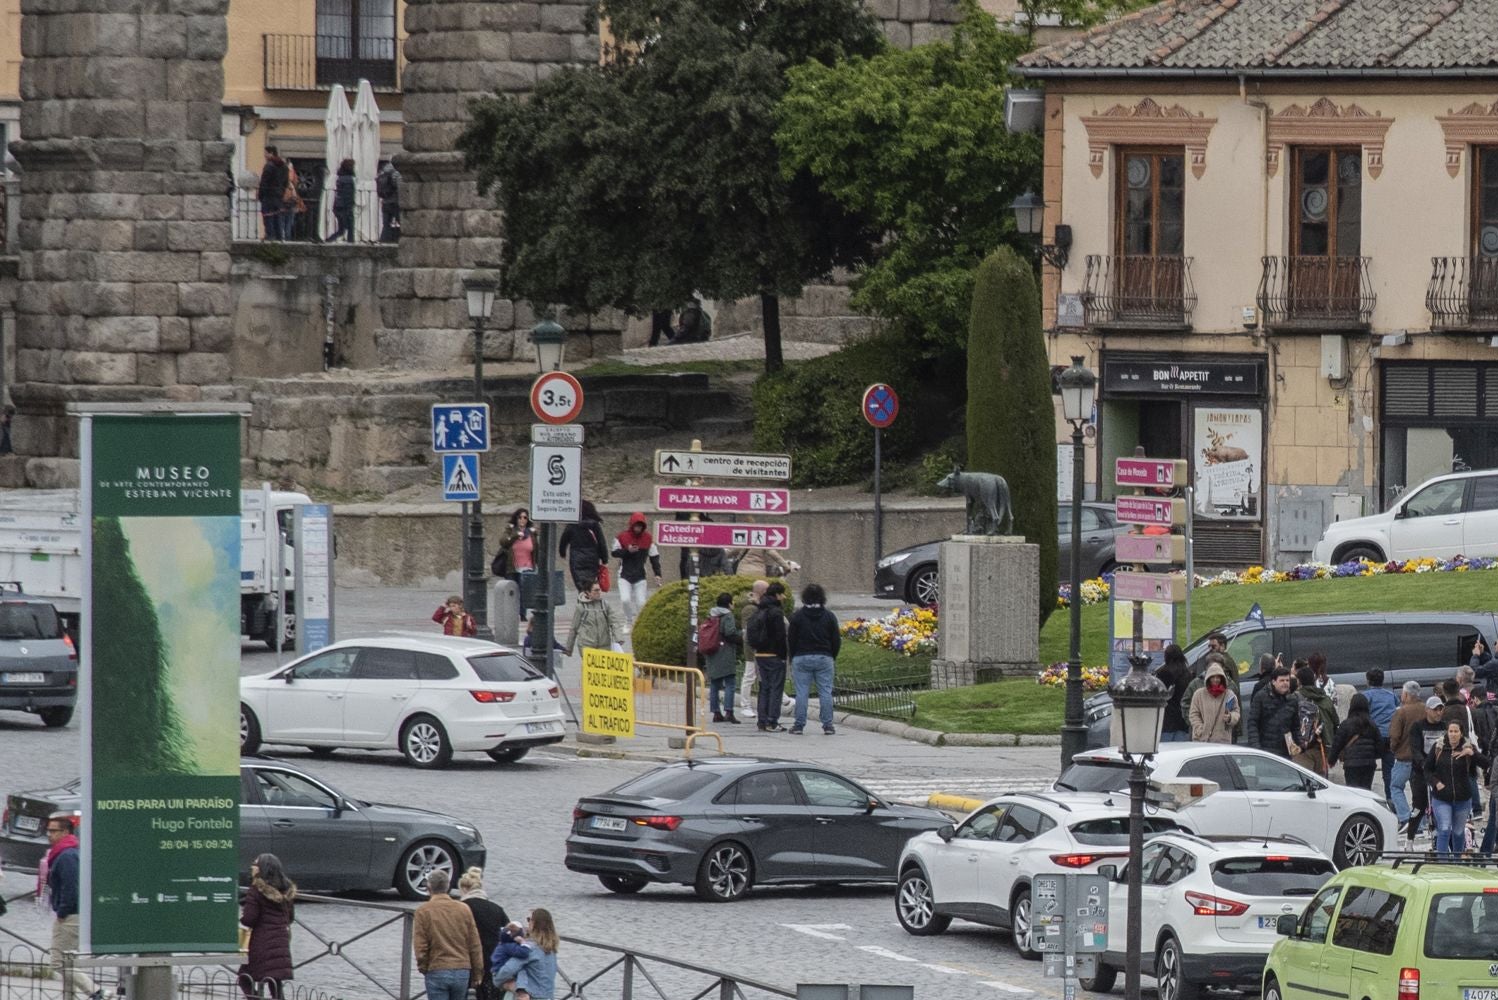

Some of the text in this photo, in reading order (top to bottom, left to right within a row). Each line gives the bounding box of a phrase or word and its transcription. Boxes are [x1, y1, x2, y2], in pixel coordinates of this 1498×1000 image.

[1153, 370, 1210, 381] BON APPETIT
[704, 456, 788, 469] centro de recepción
[136, 466, 210, 480] MUSEO
[732, 467, 787, 477] de visitantes
[125, 489, 232, 499] ESTEBAN VICENTE
[669, 494, 738, 505] PLAZA MAYOR
[662, 524, 704, 534] Catedral
[586, 654, 605, 669] CALLE
[625, 659, 629, 673] Y
[589, 692, 628, 713] CORTADAS
[588, 714, 598, 729] AL
[98, 796, 234, 810] NOTAS PARA UN PARAÍSO
[152, 817, 233, 833] Hugo Fontela
[1471, 990, 1497, 1000] 4078
